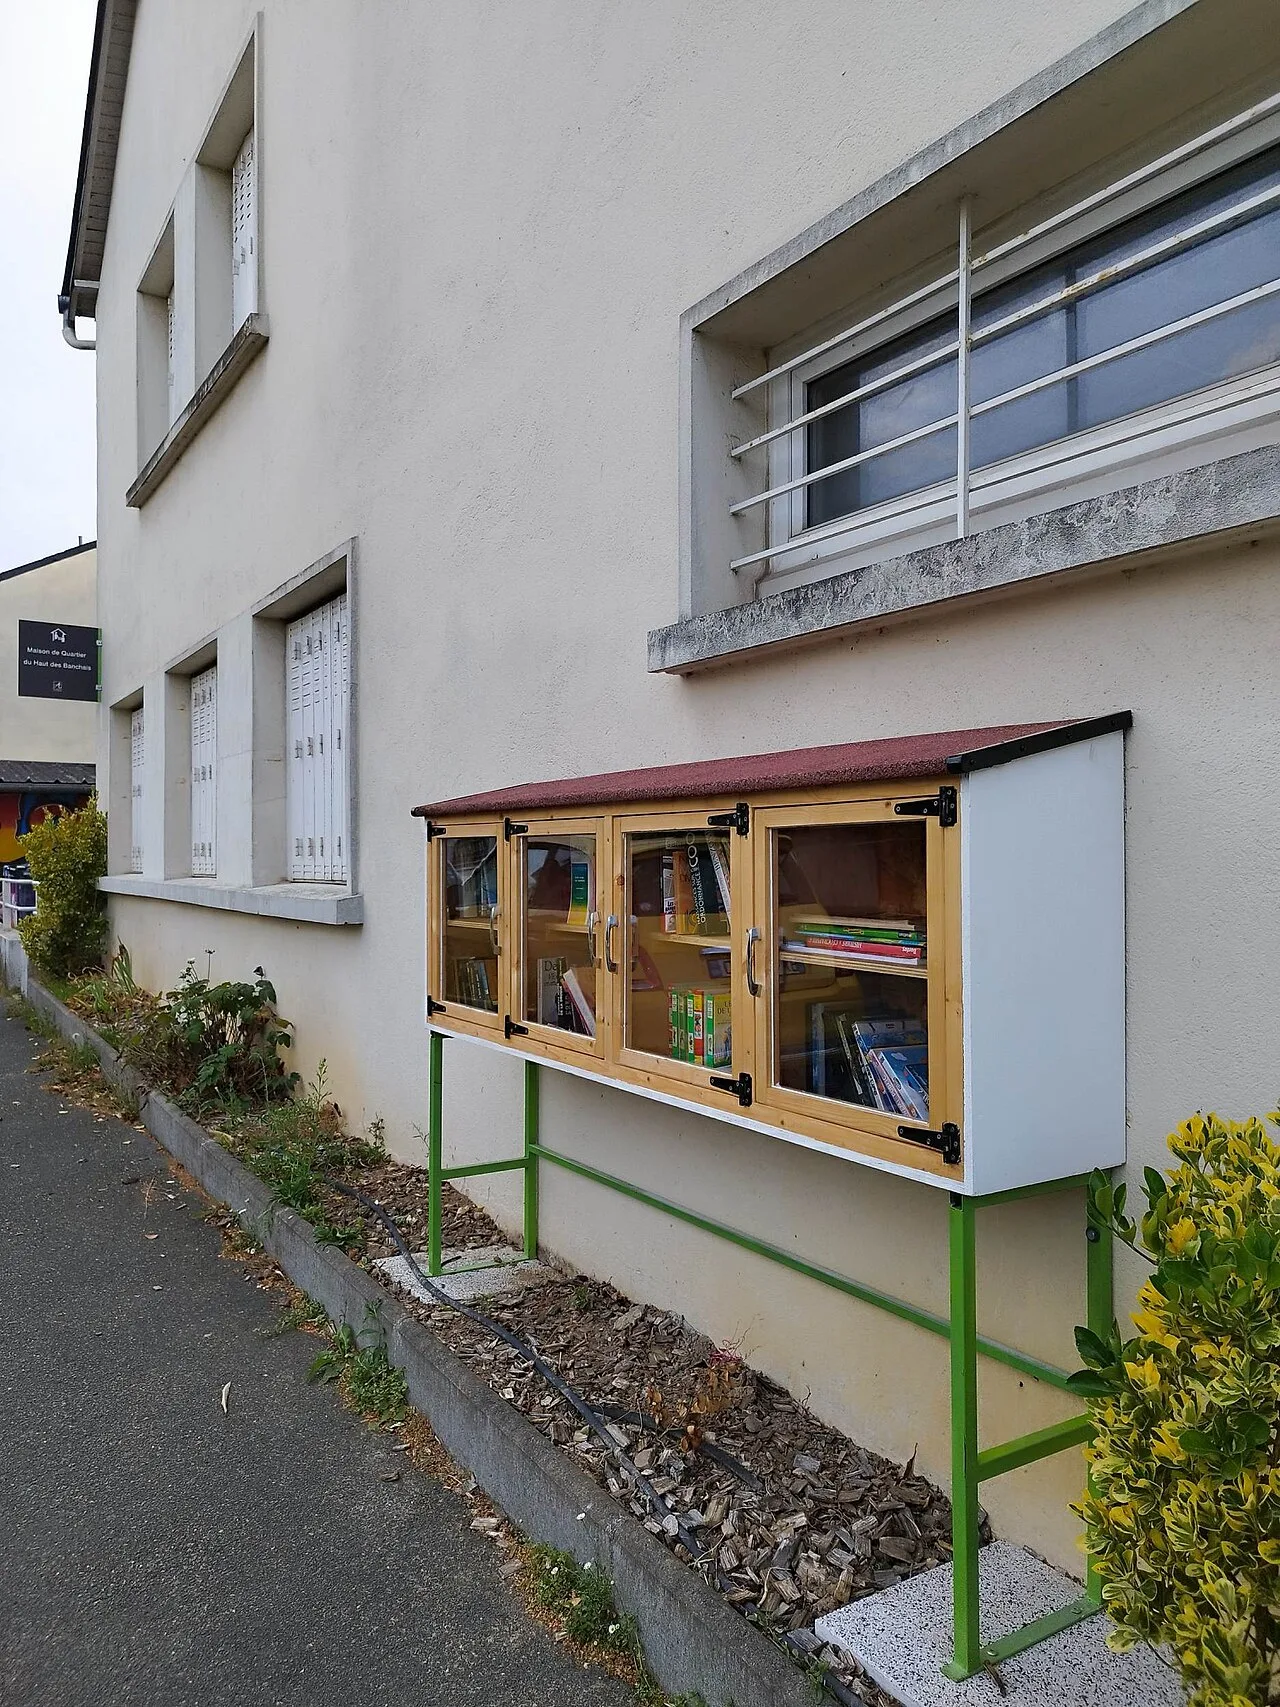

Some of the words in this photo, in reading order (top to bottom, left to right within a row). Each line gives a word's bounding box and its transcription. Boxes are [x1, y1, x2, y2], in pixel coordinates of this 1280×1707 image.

[27, 647, 50, 655] Maison
[61, 650, 86, 658] Quartier
[63, 663, 91, 671] Banchais
[695, 871, 706, 923] ORDONNANCE
